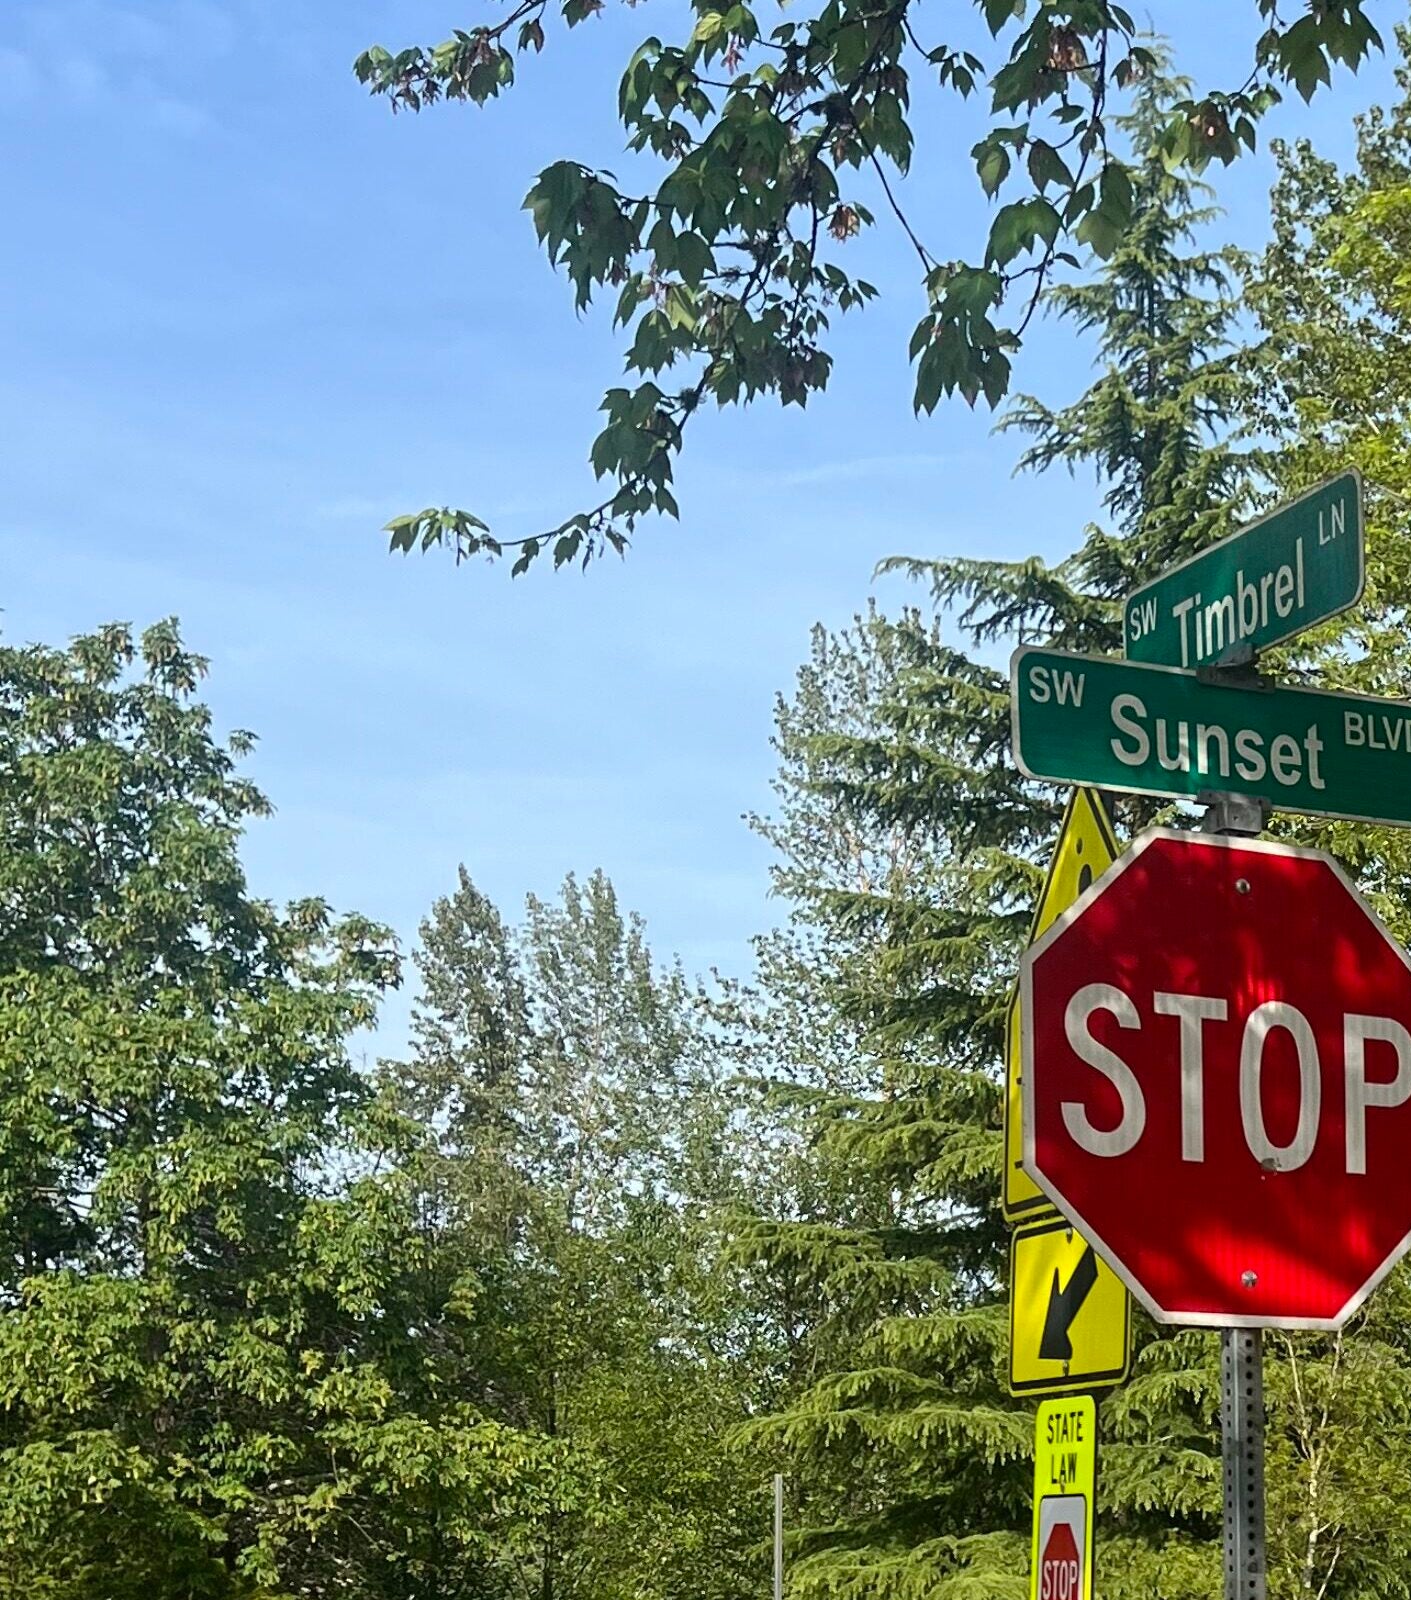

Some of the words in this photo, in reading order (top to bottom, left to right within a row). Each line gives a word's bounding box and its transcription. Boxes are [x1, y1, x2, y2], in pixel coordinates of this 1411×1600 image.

[1130, 597, 1158, 642] SW
[1172, 537, 1305, 668] Timbrel
[1318, 498, 1345, 546] LN
[1029, 665, 1085, 708] SW
[1110, 694, 1326, 790] Sunset
[1047, 1411, 1084, 1444] STATE
[1051, 1453, 1078, 1485] LAW
